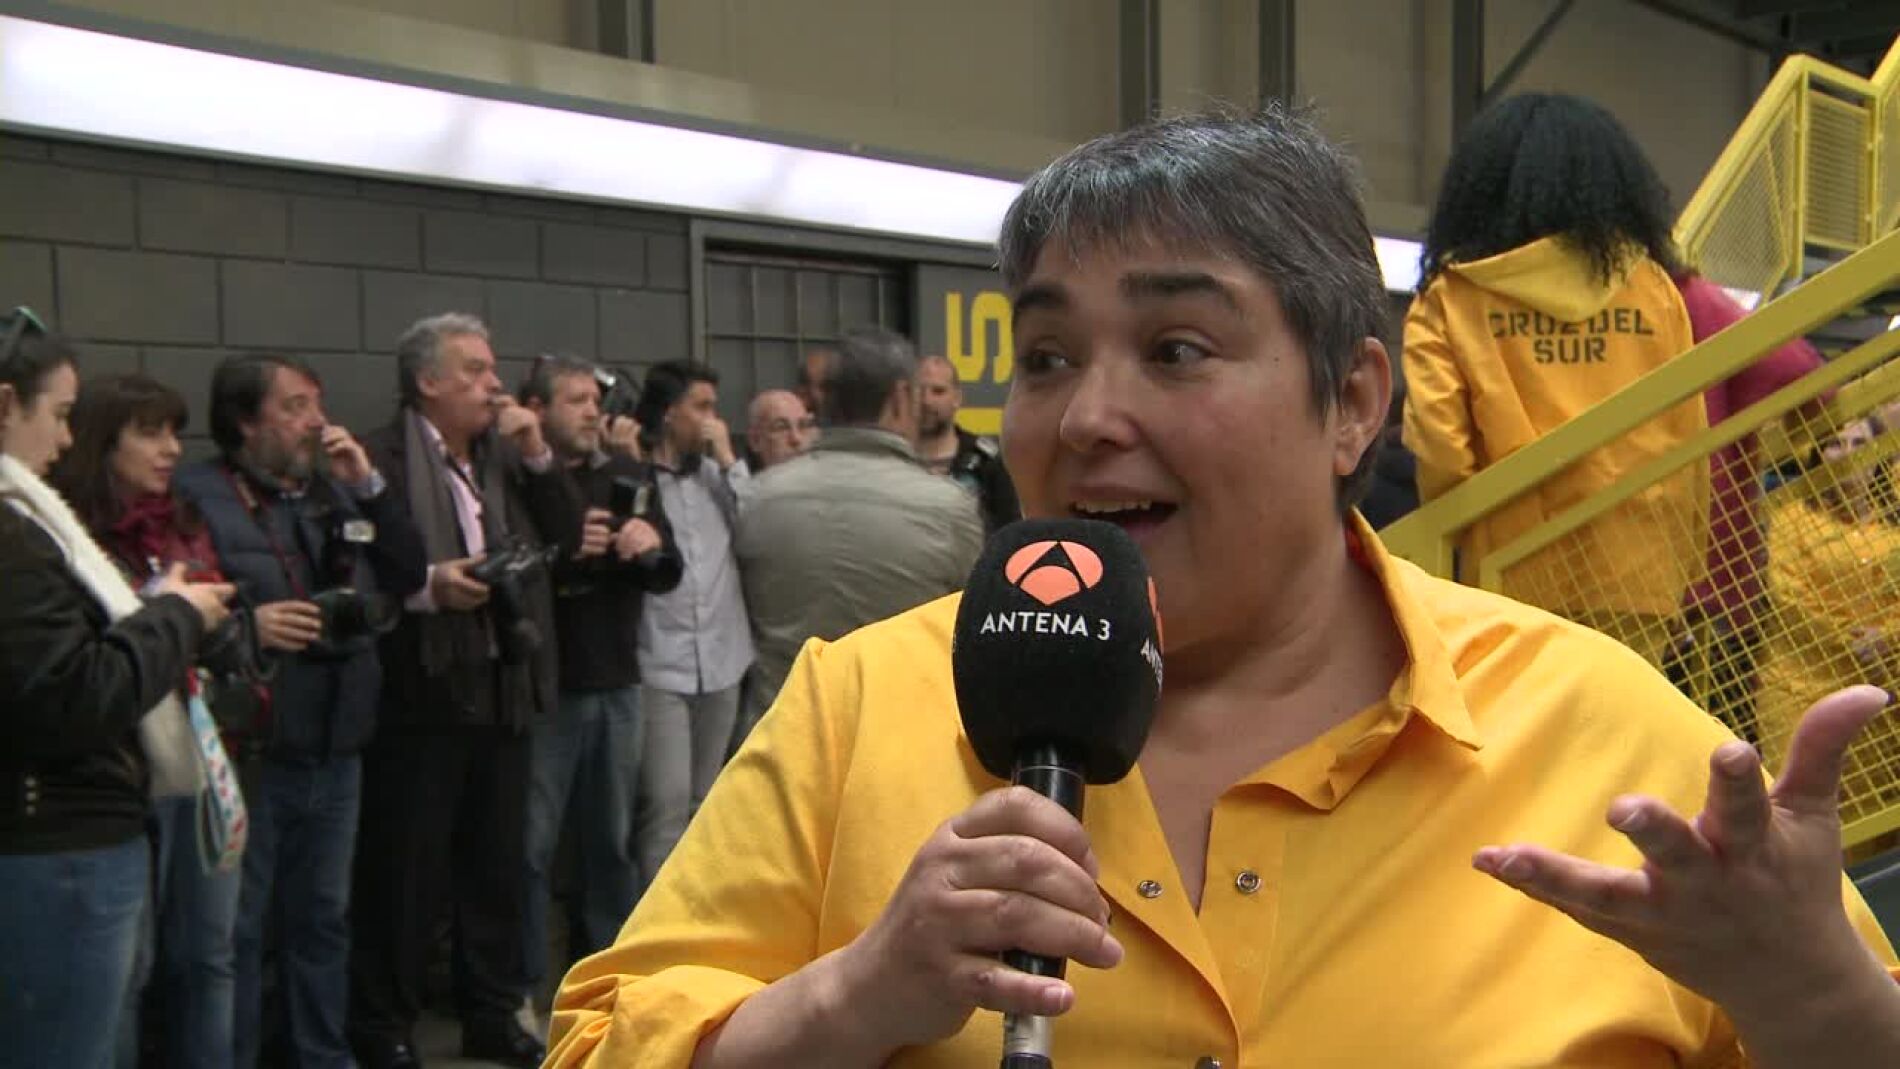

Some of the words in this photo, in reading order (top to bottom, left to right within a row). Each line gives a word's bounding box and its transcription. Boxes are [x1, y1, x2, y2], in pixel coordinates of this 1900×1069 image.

[1587, 308, 1653, 335] DEL
[1534, 337, 1607, 364] SUR
[980, 611, 1089, 637] ANTENA
[1097, 618, 1111, 641] 3
